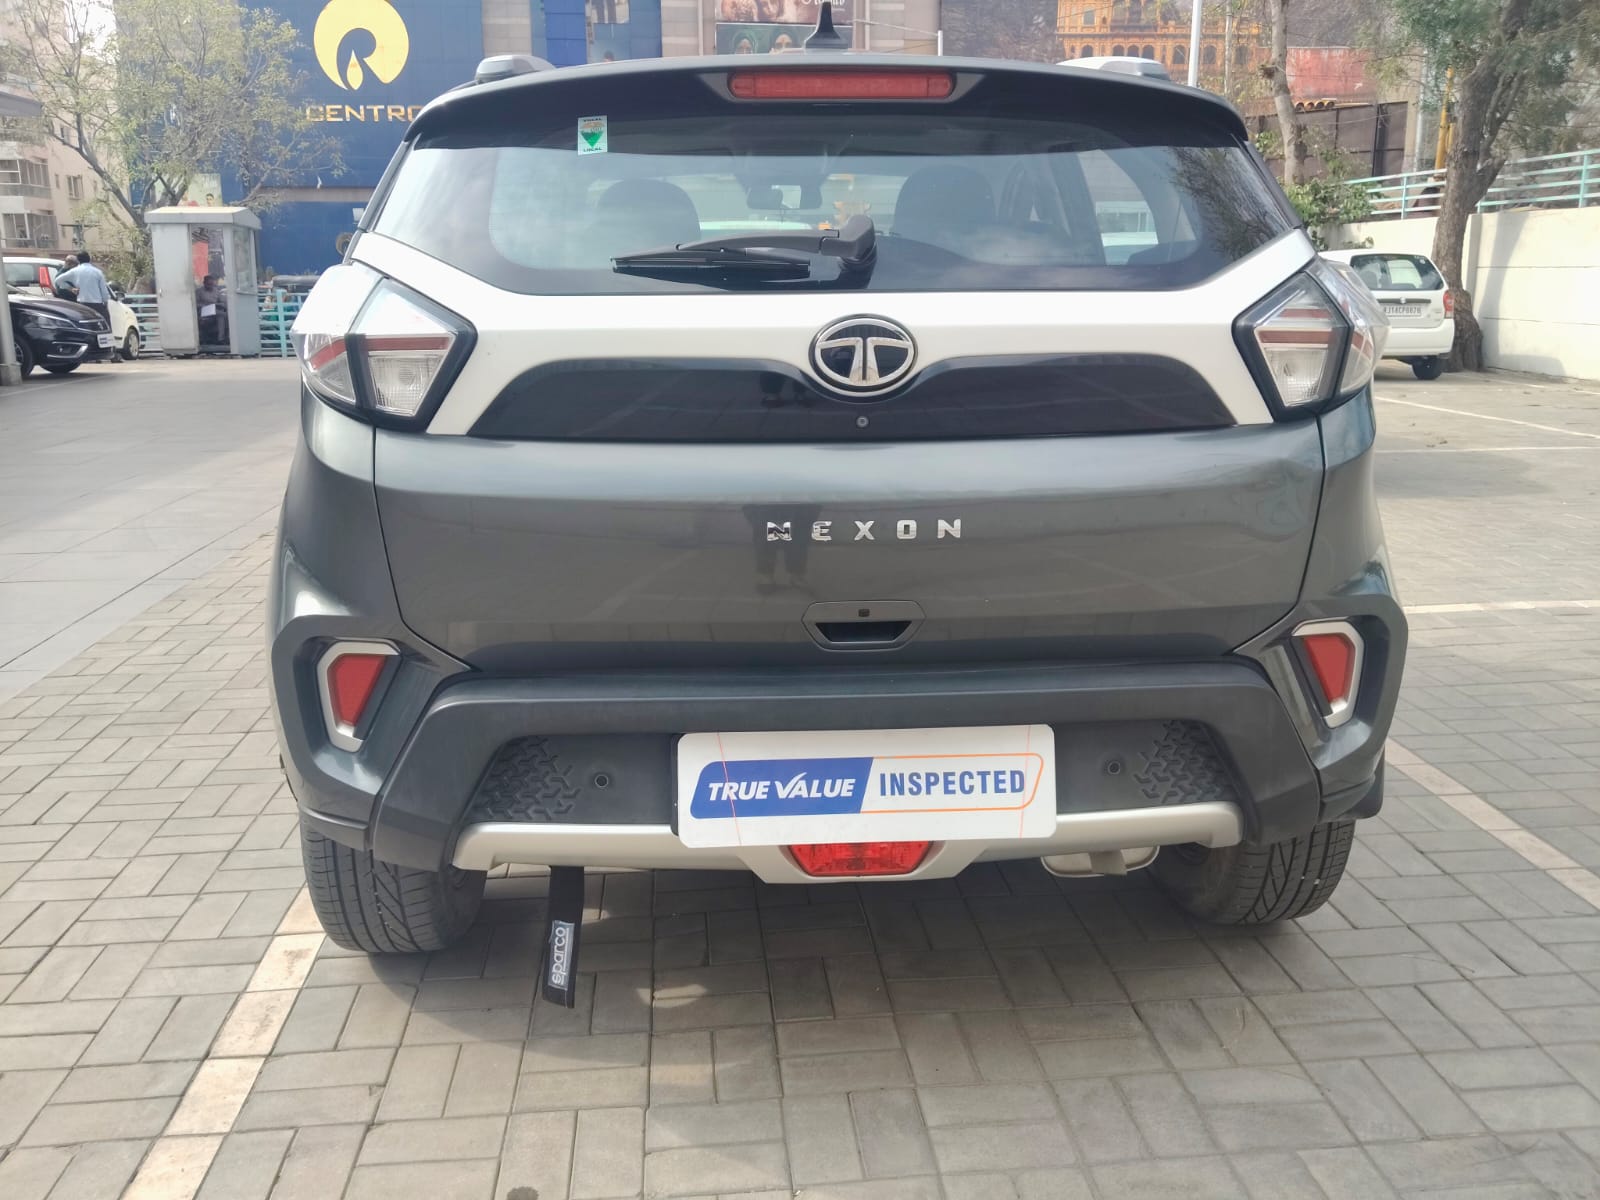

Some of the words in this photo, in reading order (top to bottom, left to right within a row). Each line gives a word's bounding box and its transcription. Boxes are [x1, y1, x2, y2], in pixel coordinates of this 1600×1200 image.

[766, 518, 962, 542] NEXON
[708, 779, 770, 801] TRUE
[774, 771, 856, 799] VALUE
[879, 769, 1026, 797] INSPECTED
[551, 927, 567, 985] sparco
